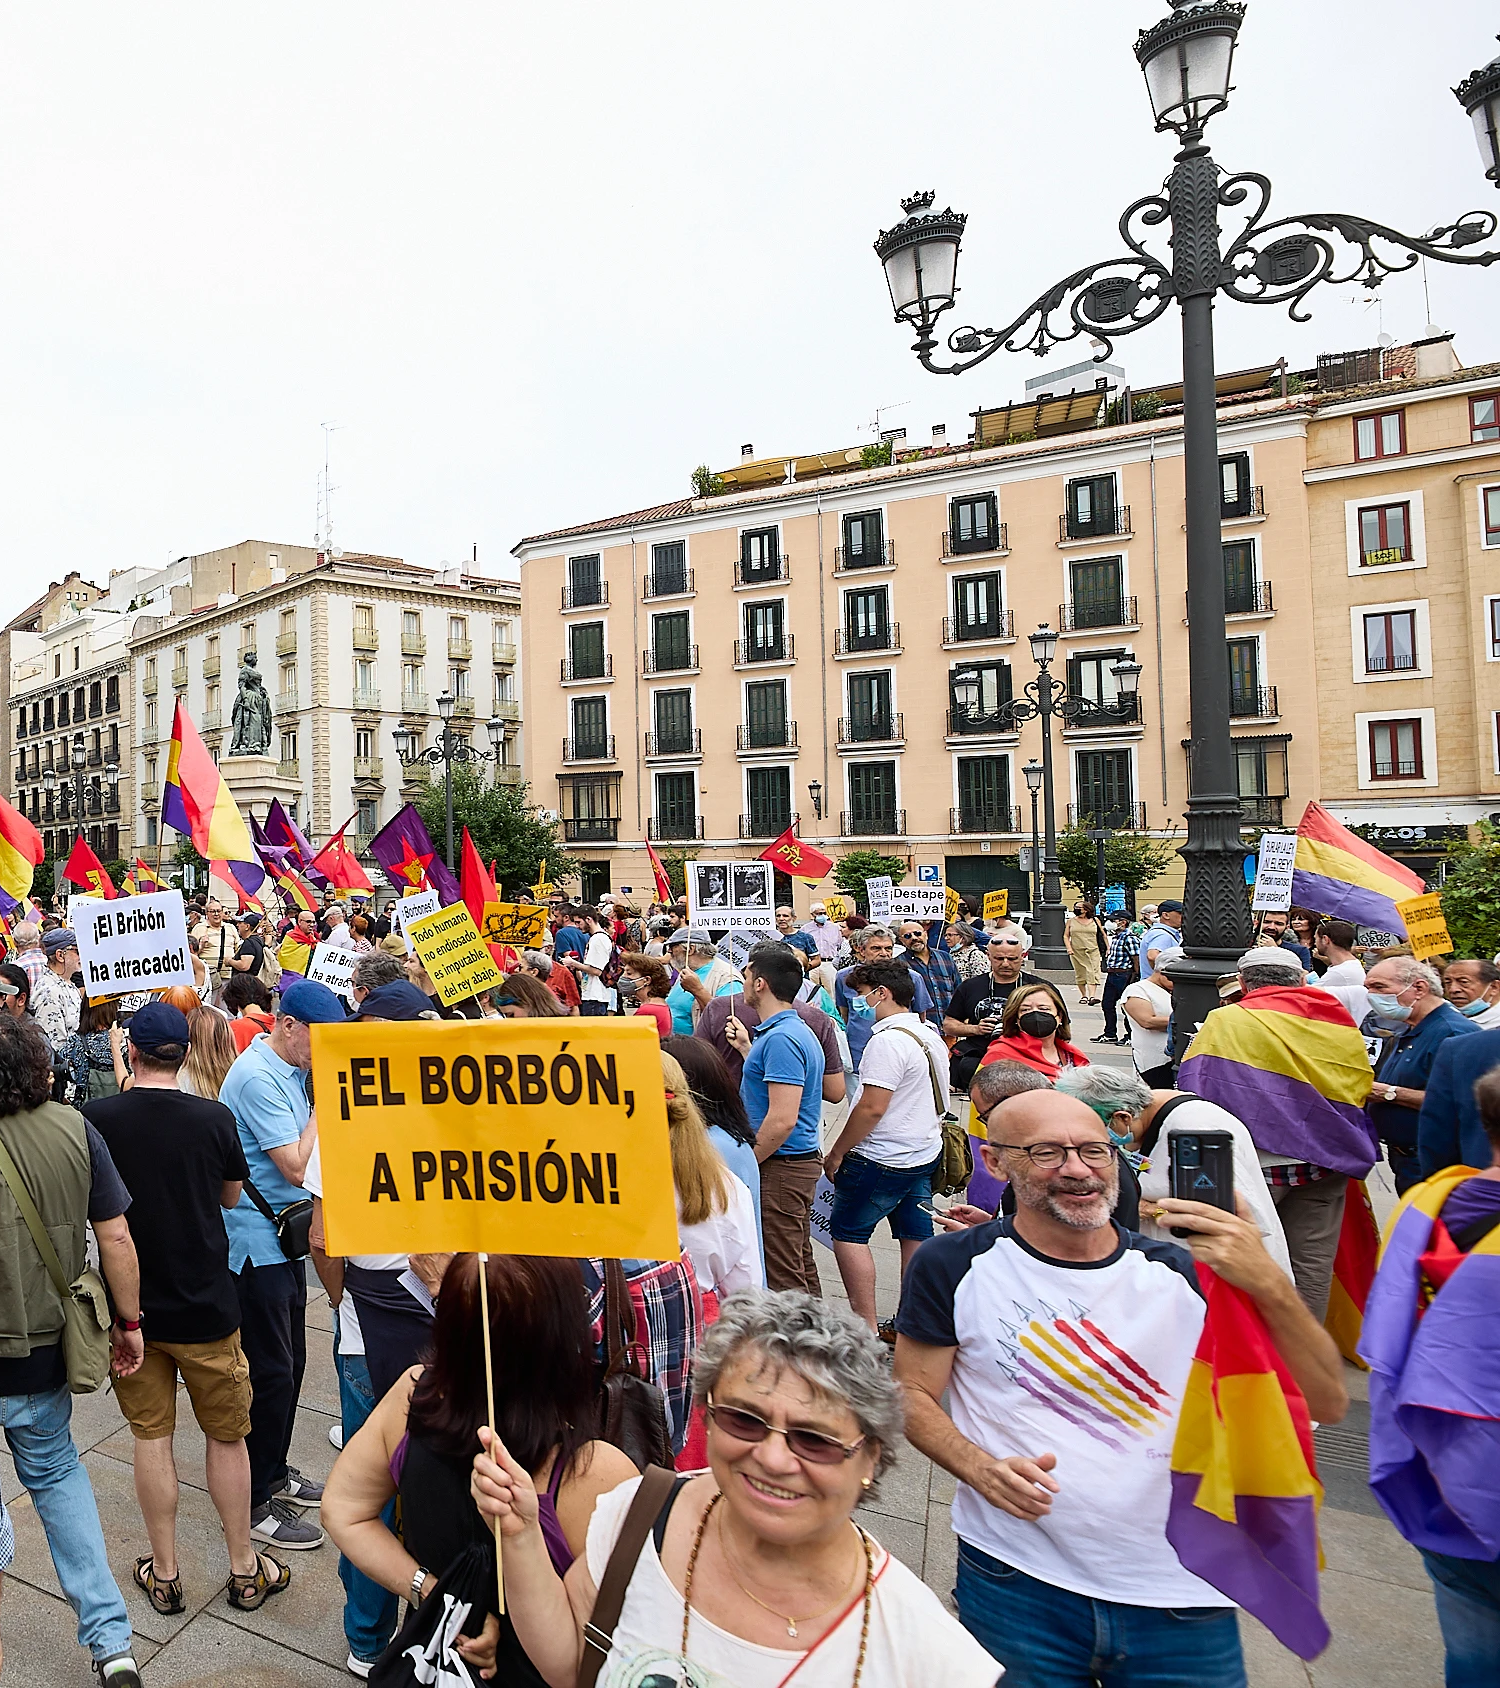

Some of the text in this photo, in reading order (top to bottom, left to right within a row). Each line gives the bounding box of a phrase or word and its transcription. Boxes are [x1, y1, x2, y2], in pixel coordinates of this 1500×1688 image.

[920, 866, 934, 881] P
[890, 888, 944, 901] ¡Destape
[890, 902, 919, 915] real,
[923, 903, 944, 915] ya!
[93, 913, 114, 945] ¡El
[116, 906, 166, 935] Bribón
[410, 912, 469, 944] Todo humano
[697, 918, 710, 927] UN
[711, 917, 728, 926] REY
[730, 917, 742, 926] DE
[744, 917, 771, 926] OROS
[323, 951, 339, 964] ¡El
[423, 929, 477, 962] no endiosado
[89, 947, 185, 983] ha atracado!
[311, 967, 324, 981] ha
[434, 948, 489, 980] es imputable,
[444, 966, 498, 998] del rey abajo.
[337, 1041, 636, 1121] ¡EL BORBÓN,
[368, 1138, 621, 1205] A PRISIÓN!
